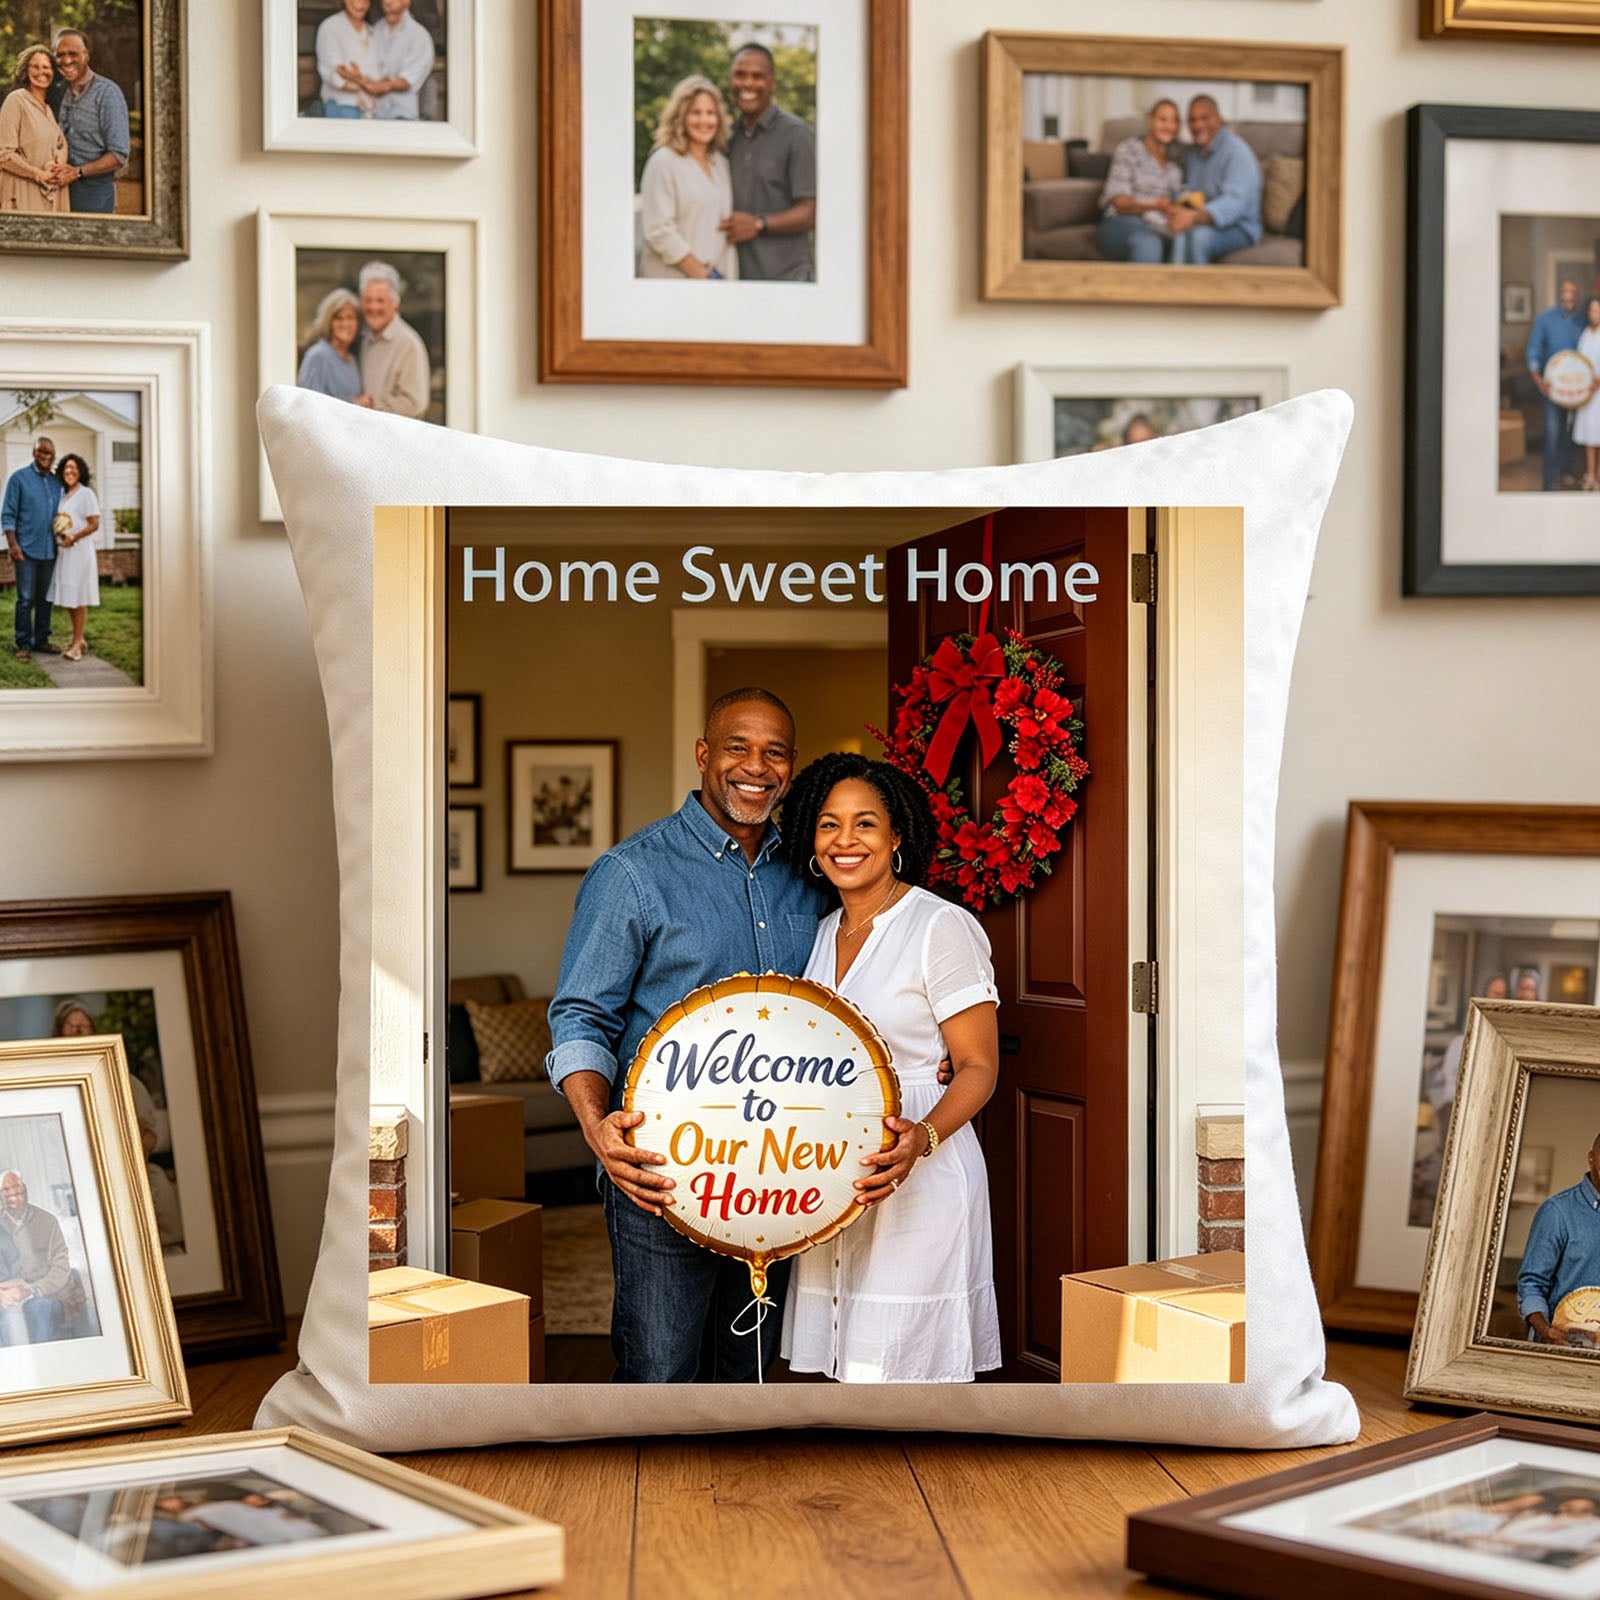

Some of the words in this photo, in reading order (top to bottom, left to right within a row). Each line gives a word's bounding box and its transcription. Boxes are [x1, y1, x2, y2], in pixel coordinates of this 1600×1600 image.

[463, 546, 660, 603] Home
[681, 545, 884, 604] Sweet
[907, 548, 1100, 603] Home
[656, 1029, 858, 1092] Welcome
[742, 1089, 777, 1122] to
[669, 1121, 748, 1167] Our
[758, 1126, 848, 1175] New
[690, 1171, 824, 1221] Home
